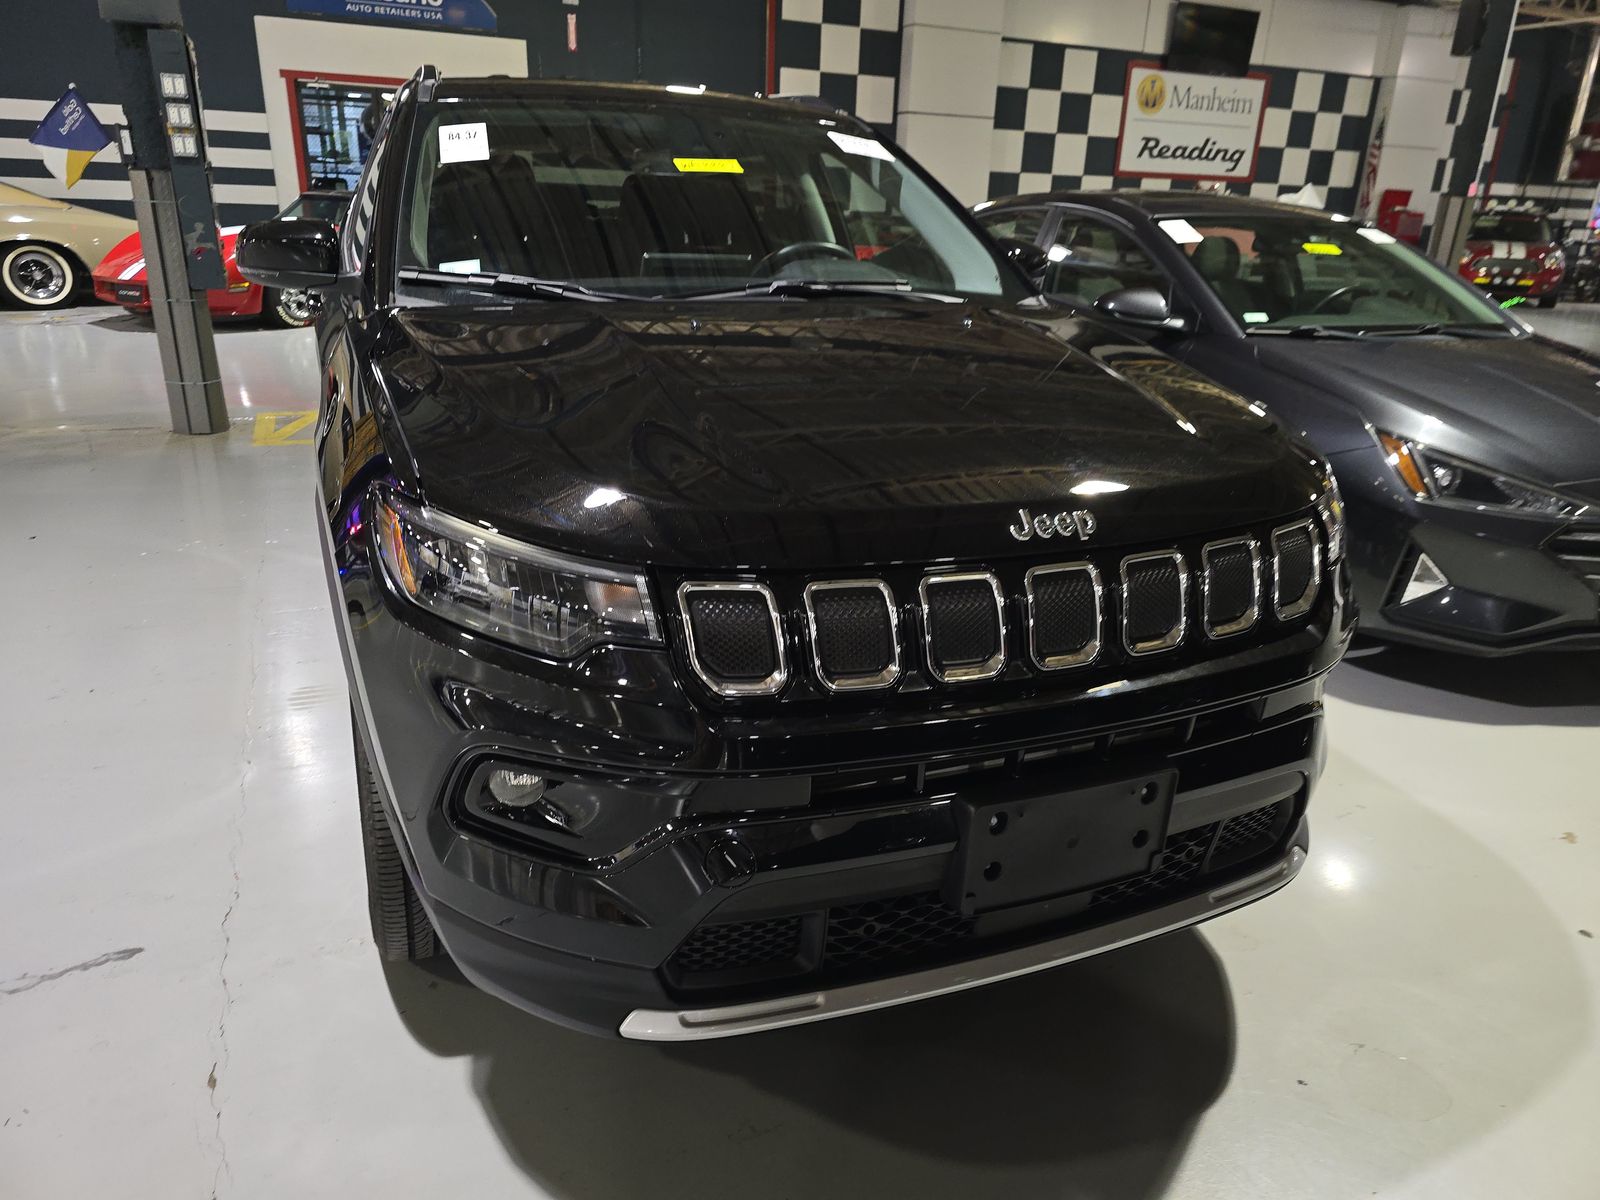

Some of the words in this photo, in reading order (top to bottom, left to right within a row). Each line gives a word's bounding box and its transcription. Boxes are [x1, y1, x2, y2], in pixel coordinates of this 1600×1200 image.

[345, 3, 372, 13] AUTO
[374, 6, 422, 18] RETAILERS
[423, 11, 443, 20] USA
[1168, 84, 1253, 115] Manheim
[1136, 136, 1247, 173] Reading
[1009, 508, 1097, 541] Jeep
